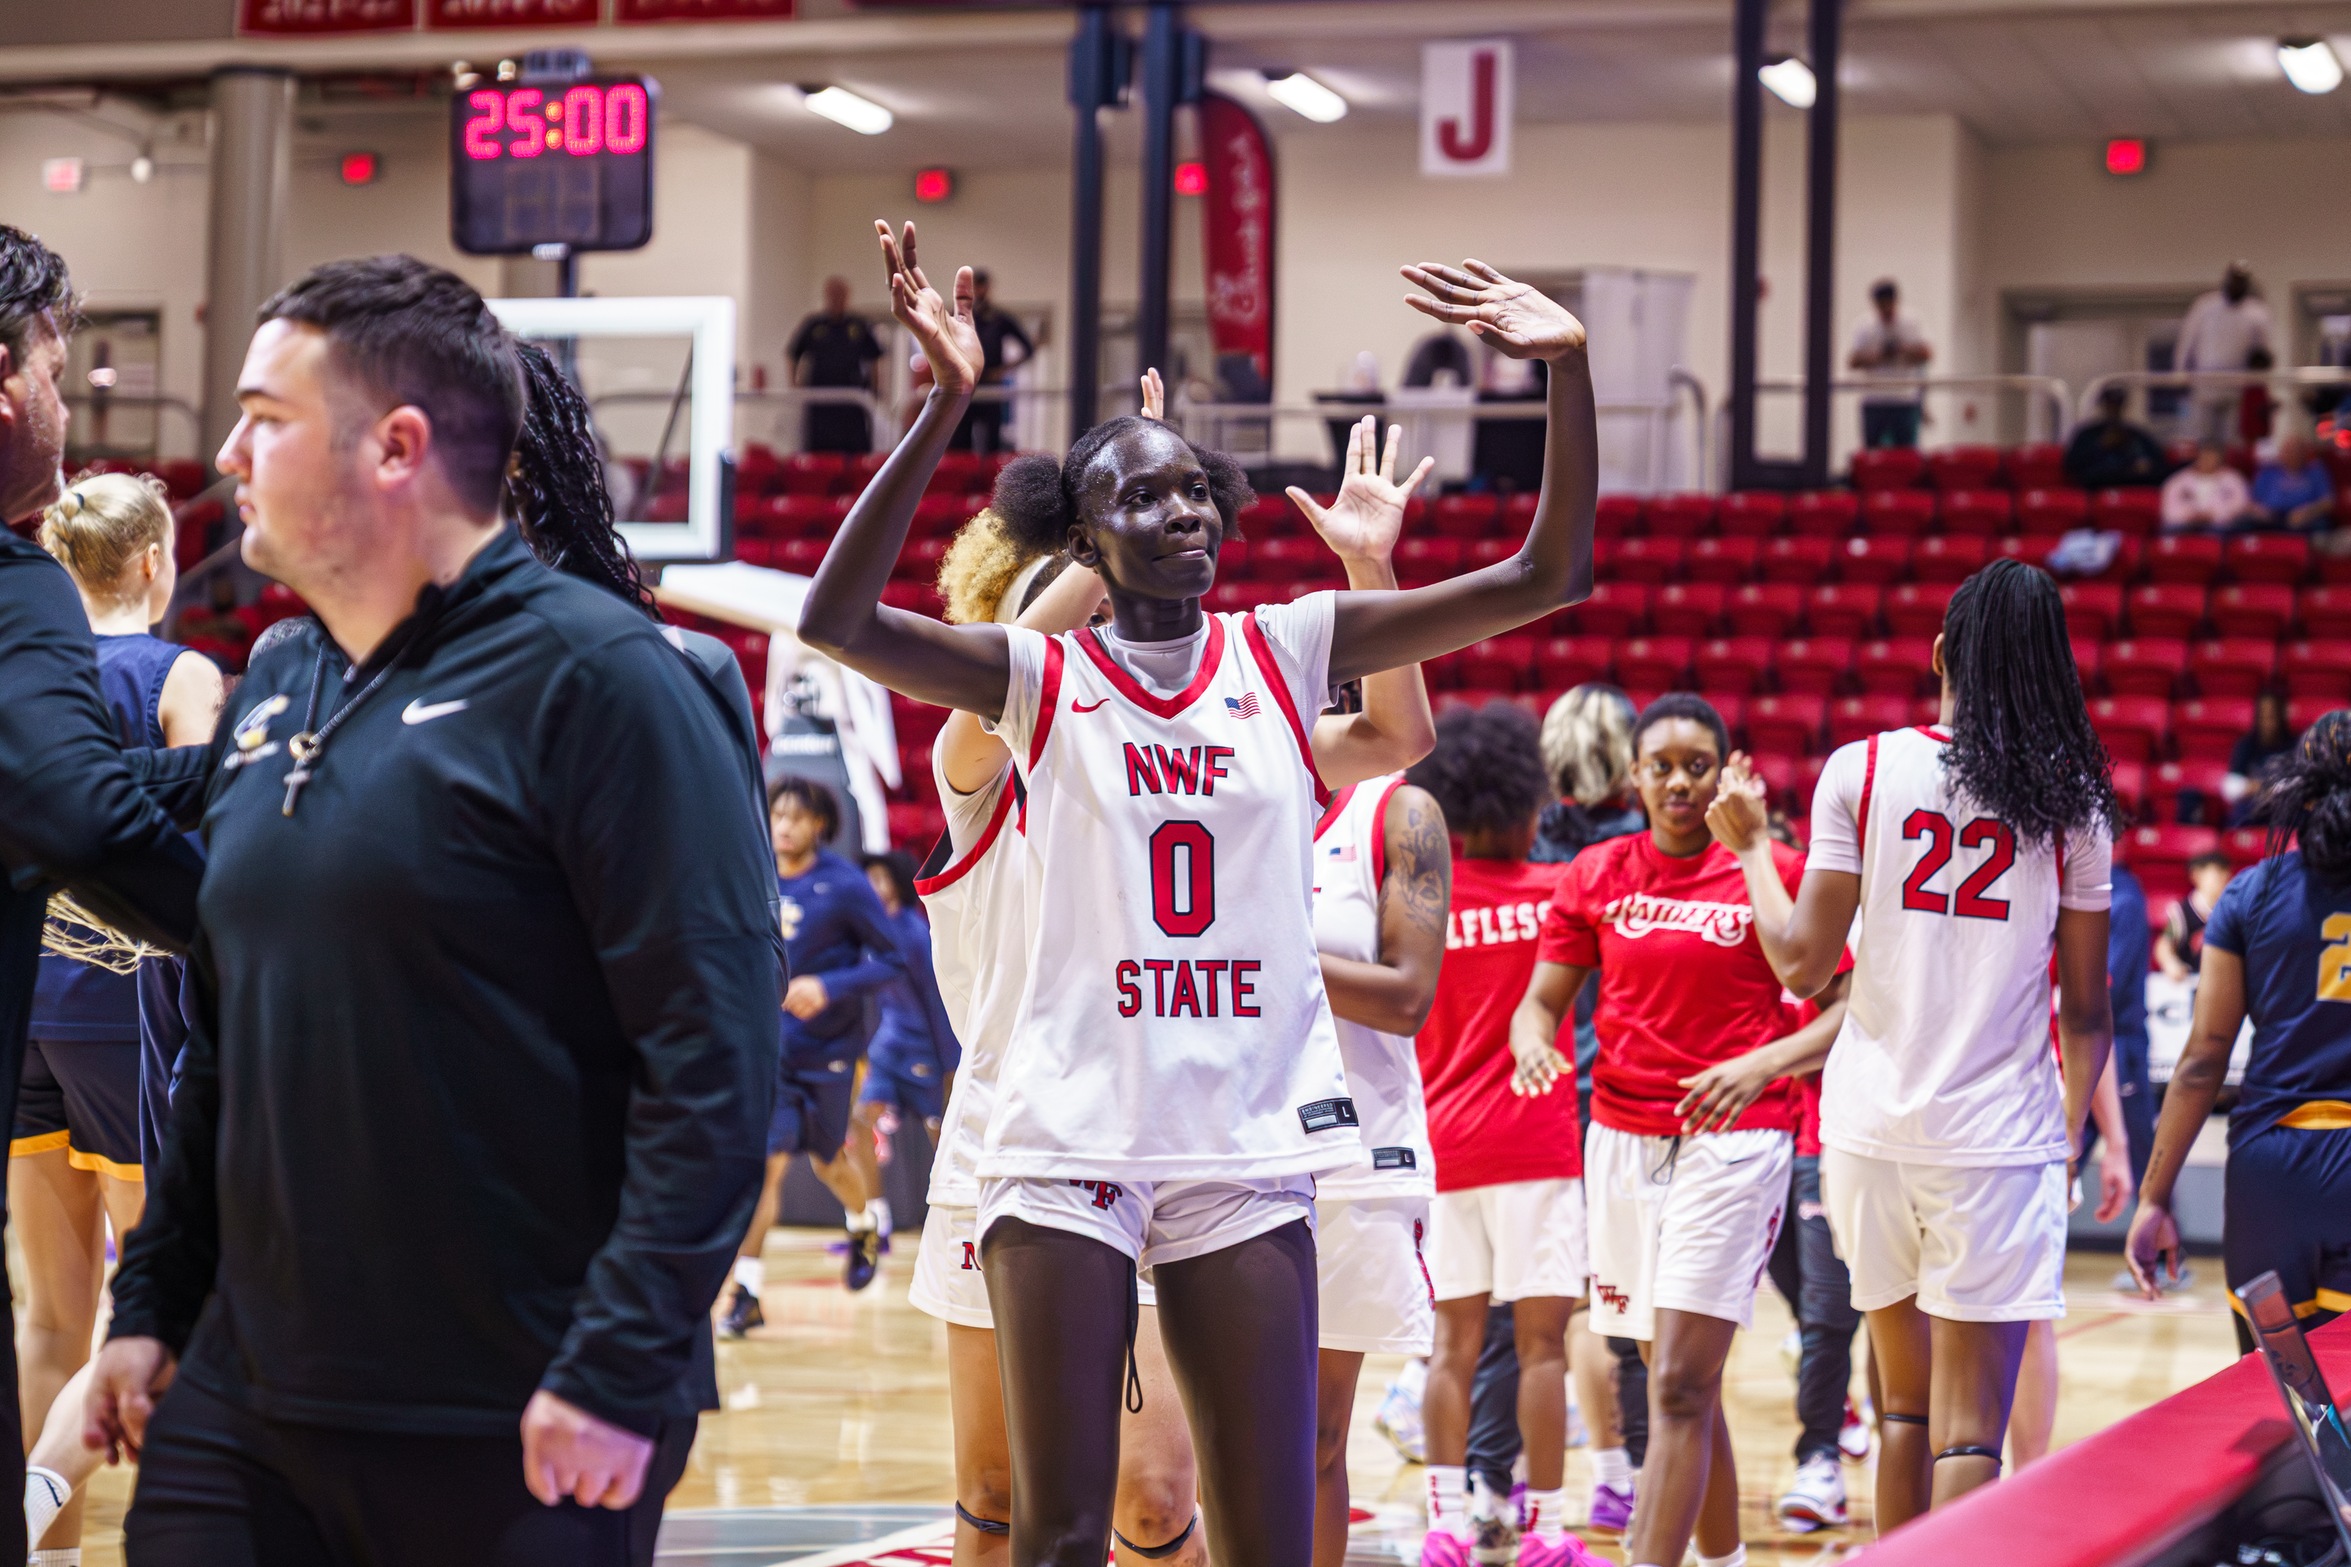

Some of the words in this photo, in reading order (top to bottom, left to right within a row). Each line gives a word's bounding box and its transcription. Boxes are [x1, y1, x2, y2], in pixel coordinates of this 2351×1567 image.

[465, 83, 648, 160] 25:00
[1436, 51, 1497, 163] J
[1123, 742, 1235, 796] NWF
[1149, 820, 1215, 937] 0
[1902, 808, 2017, 922] 22
[1116, 959, 1261, 1018] STATE
[1342, 1106, 1350, 1118] L
